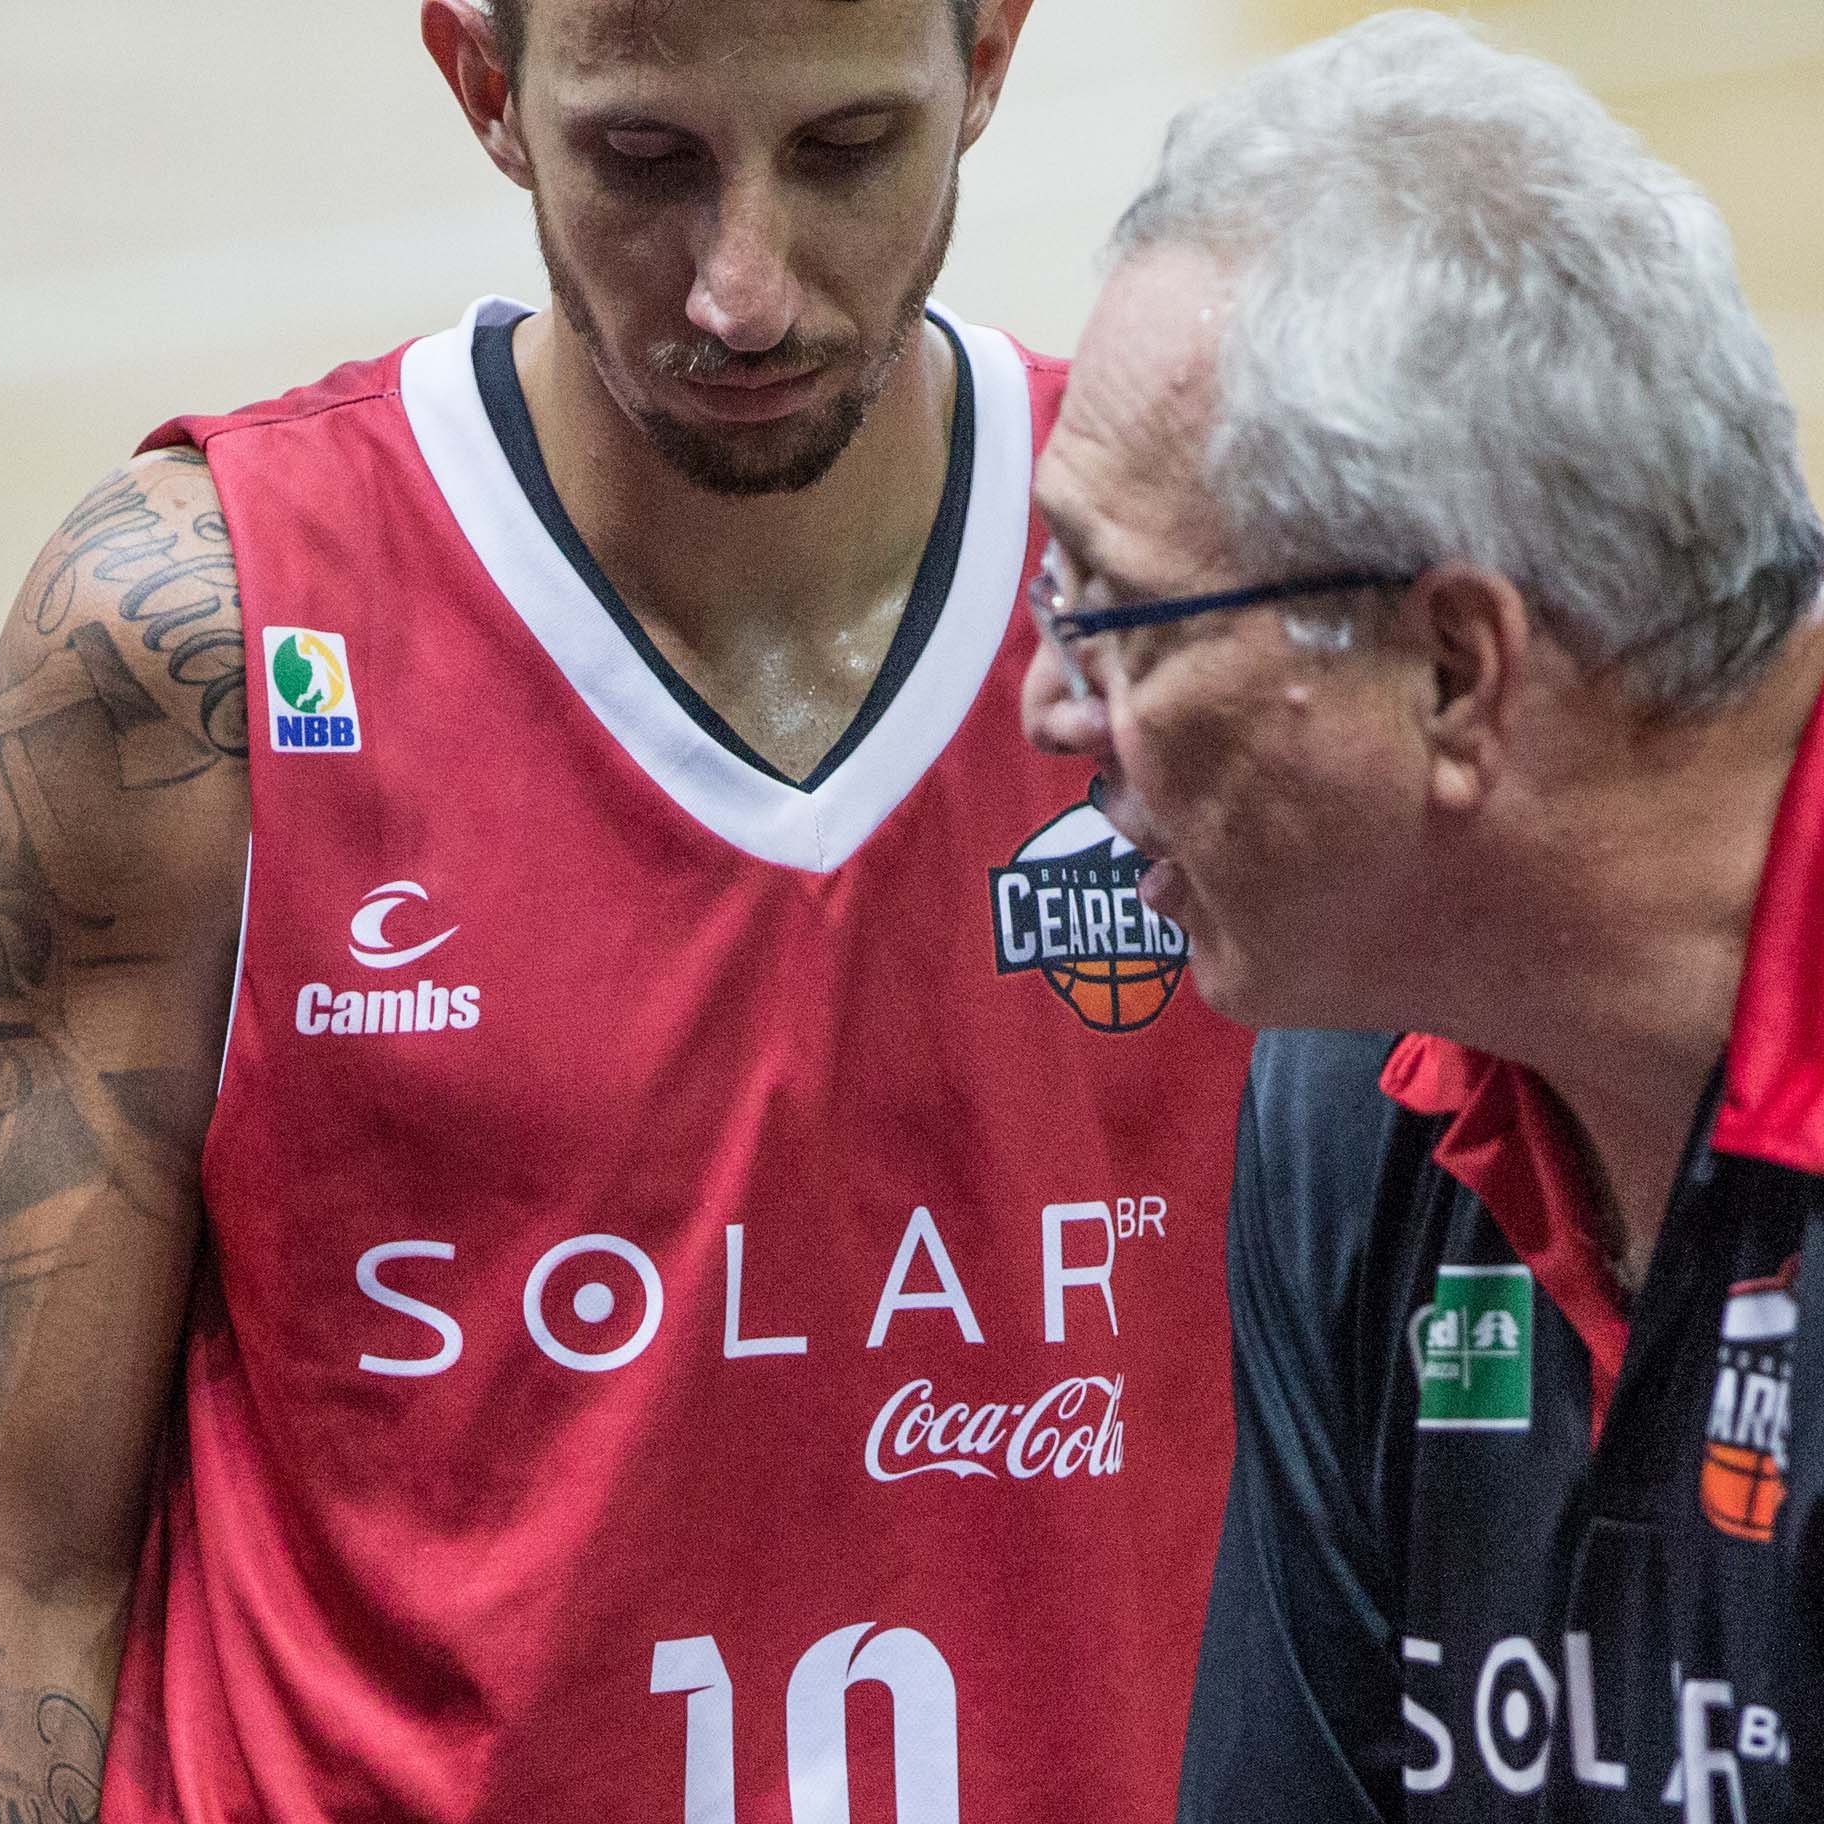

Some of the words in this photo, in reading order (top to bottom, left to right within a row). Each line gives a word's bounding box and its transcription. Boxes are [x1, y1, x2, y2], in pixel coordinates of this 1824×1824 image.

[276, 714, 356, 749] NBB
[997, 872, 1191, 964] CEARENS
[295, 979, 481, 1037] Cambs
[355, 1200, 1119, 1377] SOLAR
[1117, 1195, 1168, 1240] BR
[863, 1371, 1126, 1484] Coca-Cola
